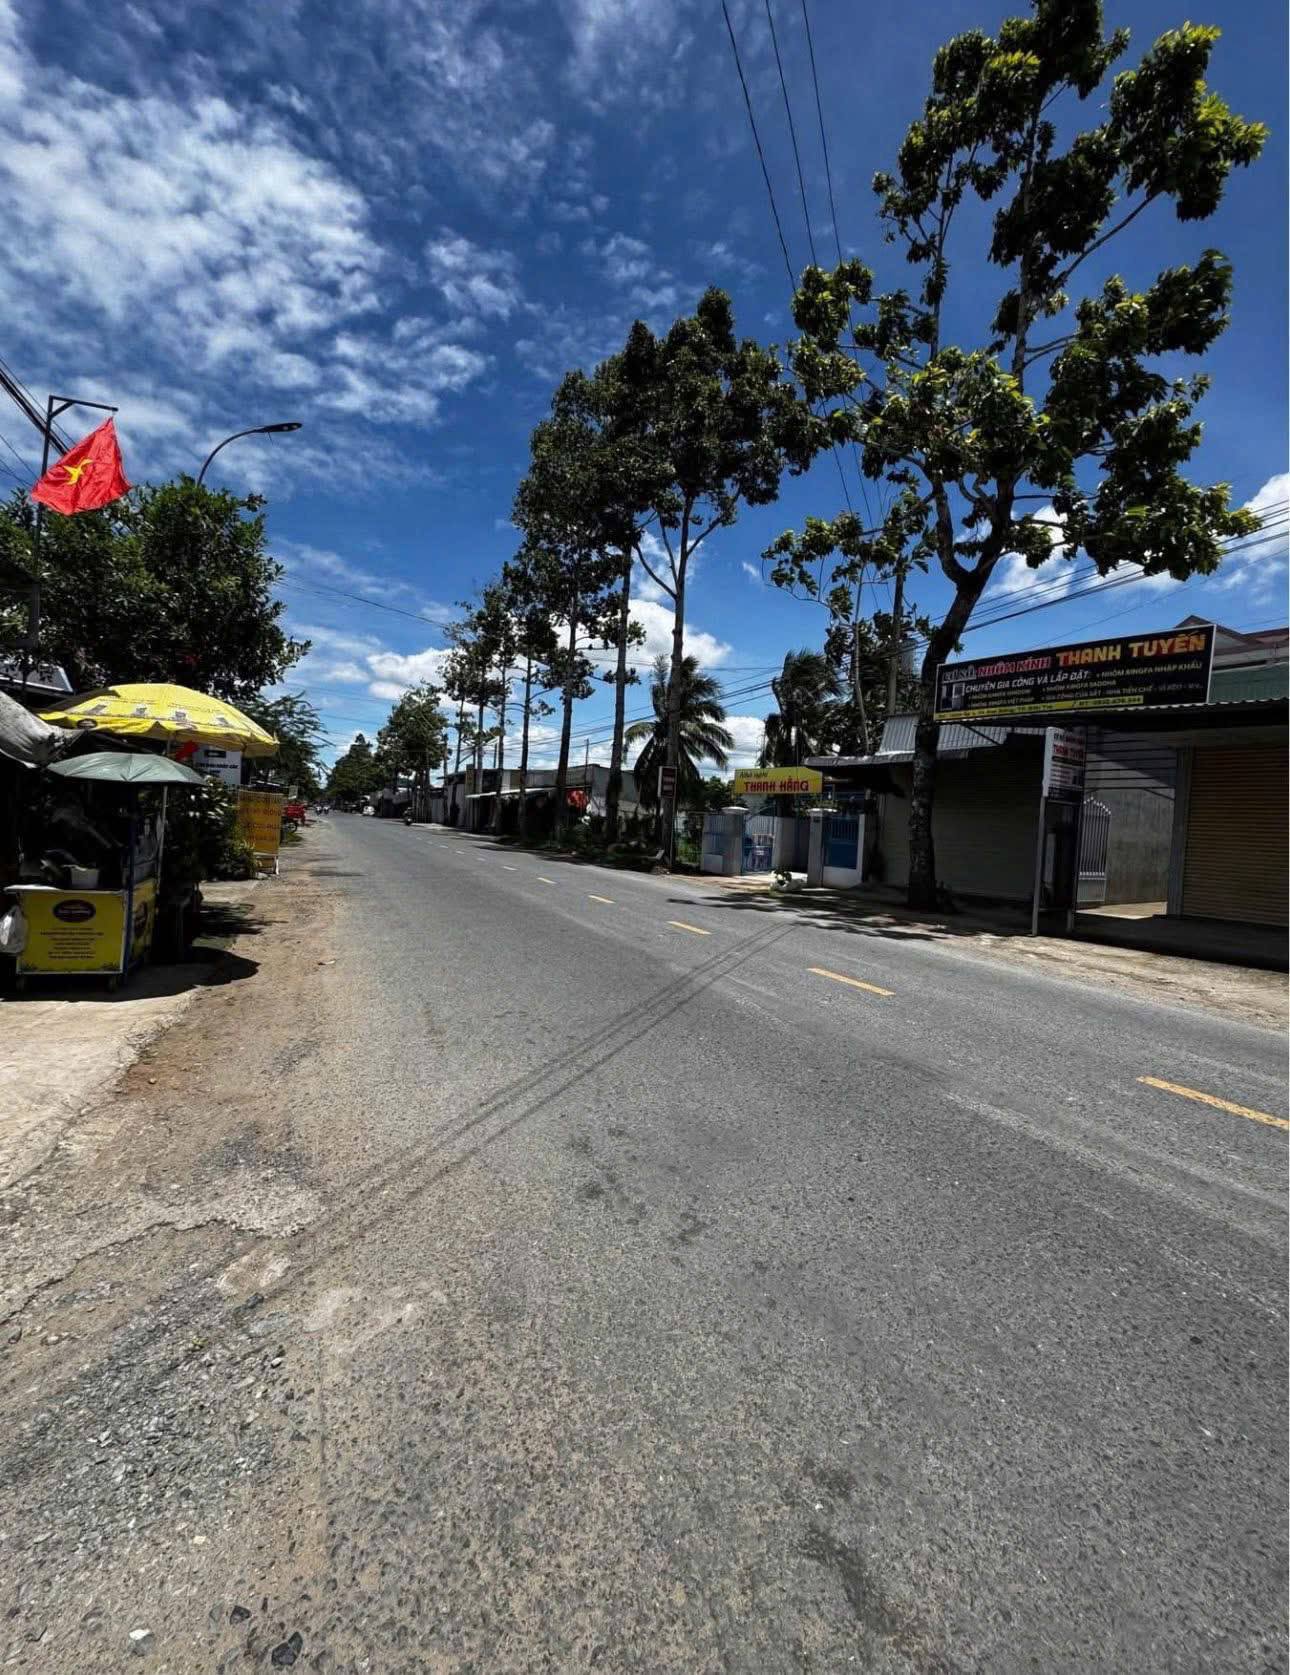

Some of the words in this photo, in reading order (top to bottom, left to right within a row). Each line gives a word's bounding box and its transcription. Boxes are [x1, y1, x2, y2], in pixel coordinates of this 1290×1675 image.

[1055, 644, 1122, 666] THANH
[1128, 631, 1207, 657] TUYẾN
[996, 679, 1010, 689] GIA
[1012, 676, 1035, 688] CÔNG
